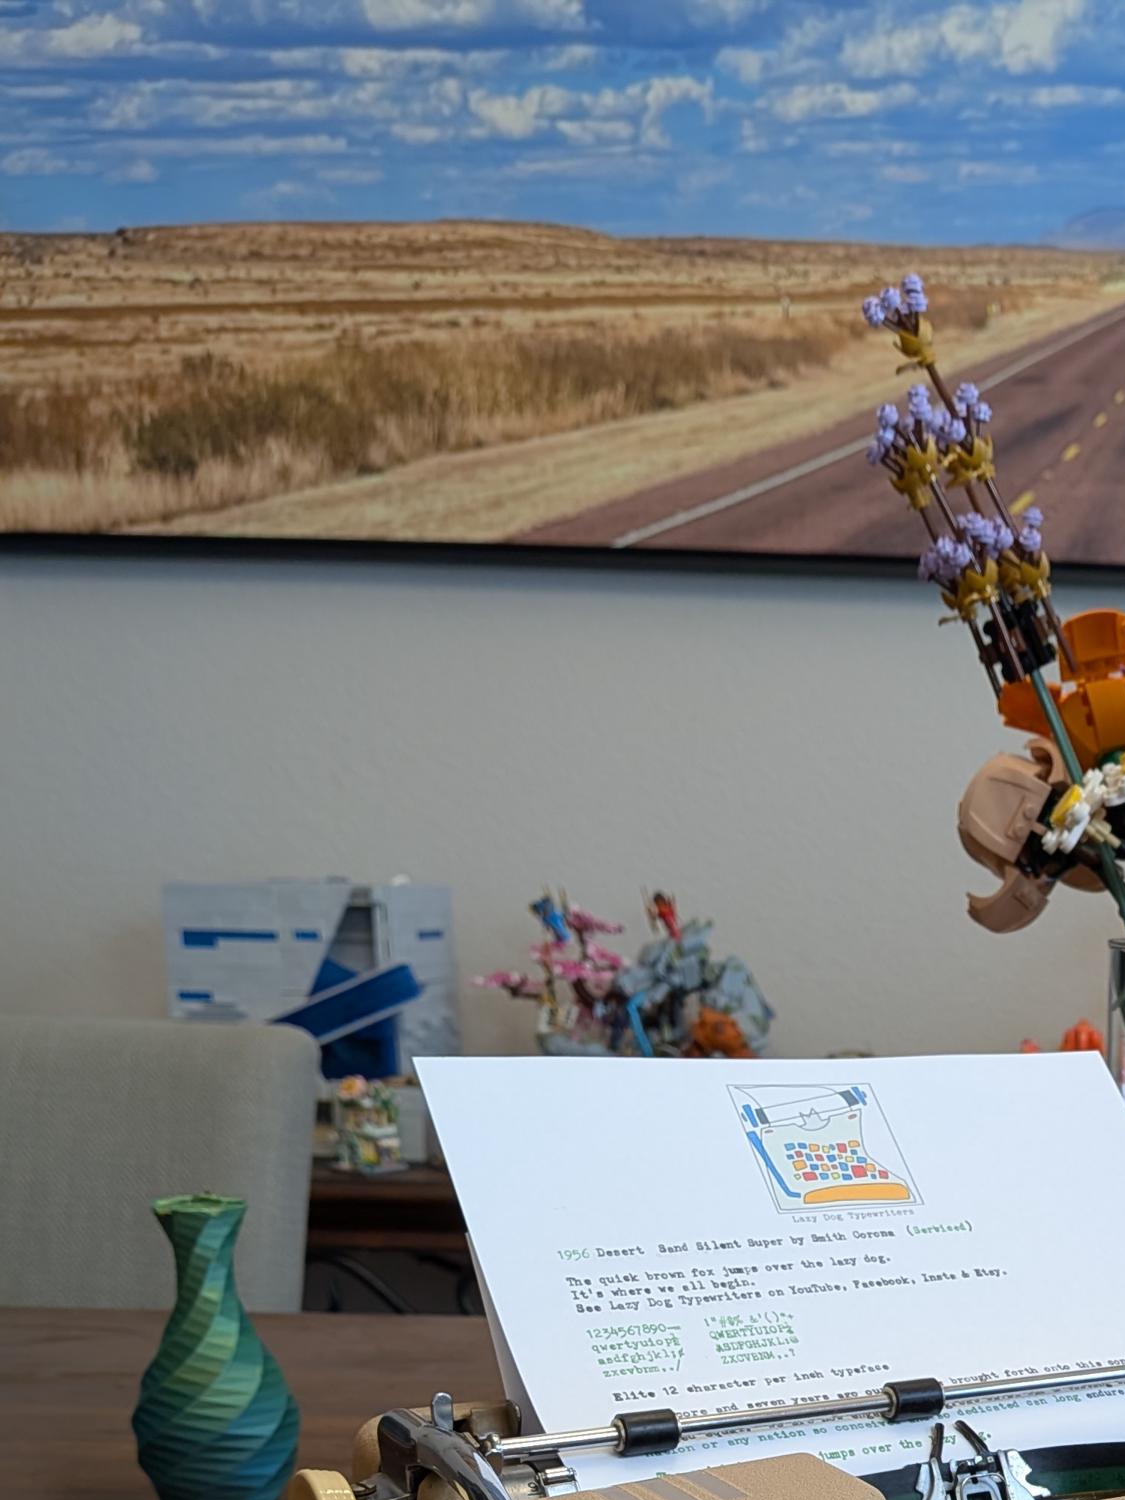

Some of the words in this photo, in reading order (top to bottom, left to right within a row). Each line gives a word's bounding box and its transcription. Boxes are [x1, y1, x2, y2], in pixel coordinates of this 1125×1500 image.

[792, 1215, 817, 1225] Lazy
[823, 1213, 843, 1222] Dog
[847, 1208, 915, 1220] Typewriters
[557, 1248, 590, 1261] 1956
[595, 1246, 645, 1258] Desert
[695, 1240, 742, 1251] Silent
[747, 1238, 783, 1249] Super
[789, 1236, 804, 1246] by
[811, 1232, 847, 1243] Smith
[852, 1230, 895, 1240] Corona
[565, 1277, 592, 1287] The
[598, 1272, 641, 1287] quick
[645, 1271, 686, 1281] brown
[691, 1267, 715, 1278] fox
[722, 1265, 758, 1277] jumps
[764, 1262, 794, 1272] over
[800, 1259, 824, 1269] the
[830, 1256, 857, 1267] lazy
[864, 1253, 891, 1265] dog.
[576, 1303, 602, 1313] See
[609, 1300, 640, 1312] Lazy
[647, 1297, 674, 1309] Dog
[678, 1291, 762, 1306] Typewriters
[768, 1288, 785, 1297] on
[788, 1282, 848, 1296] YouTube,
[921, 1272, 957, 1283] Insta
[961, 1270, 970, 1279] &
[974, 1267, 1008, 1279] Etsy.
[611, 1287, 651, 1297] where
[657, 1285, 675, 1293] we
[710, 1278, 756, 1290] begin.
[612, 1388, 656, 1402] Elite
[662, 1385, 679, 1396] 12
[686, 1376, 757, 1394] character
[764, 1374, 787, 1387] per
[795, 1369, 825, 1382] inch
[831, 1362, 891, 1378] typeface
[716, 1402, 738, 1413] and
[747, 1397, 785, 1410] seven
[791, 1393, 830, 1406] years
[948, 1371, 1000, 1385] brought
[1004, 1366, 1039, 1378] forth
[1076, 1359, 1102, 1369] this
[702, 1441, 718, 1450] or
[728, 1436, 750, 1447] any
[758, 1428, 807, 1443] nation
[813, 1427, 828, 1436] so
[957, 1401, 1020, 1417] dedicated
[1025, 1398, 1048, 1406] can
[1052, 1392, 1082, 1403] long
[818, 1448, 856, 1462] jumps
[862, 1442, 893, 1455] over
[899, 1438, 923, 1450] the
